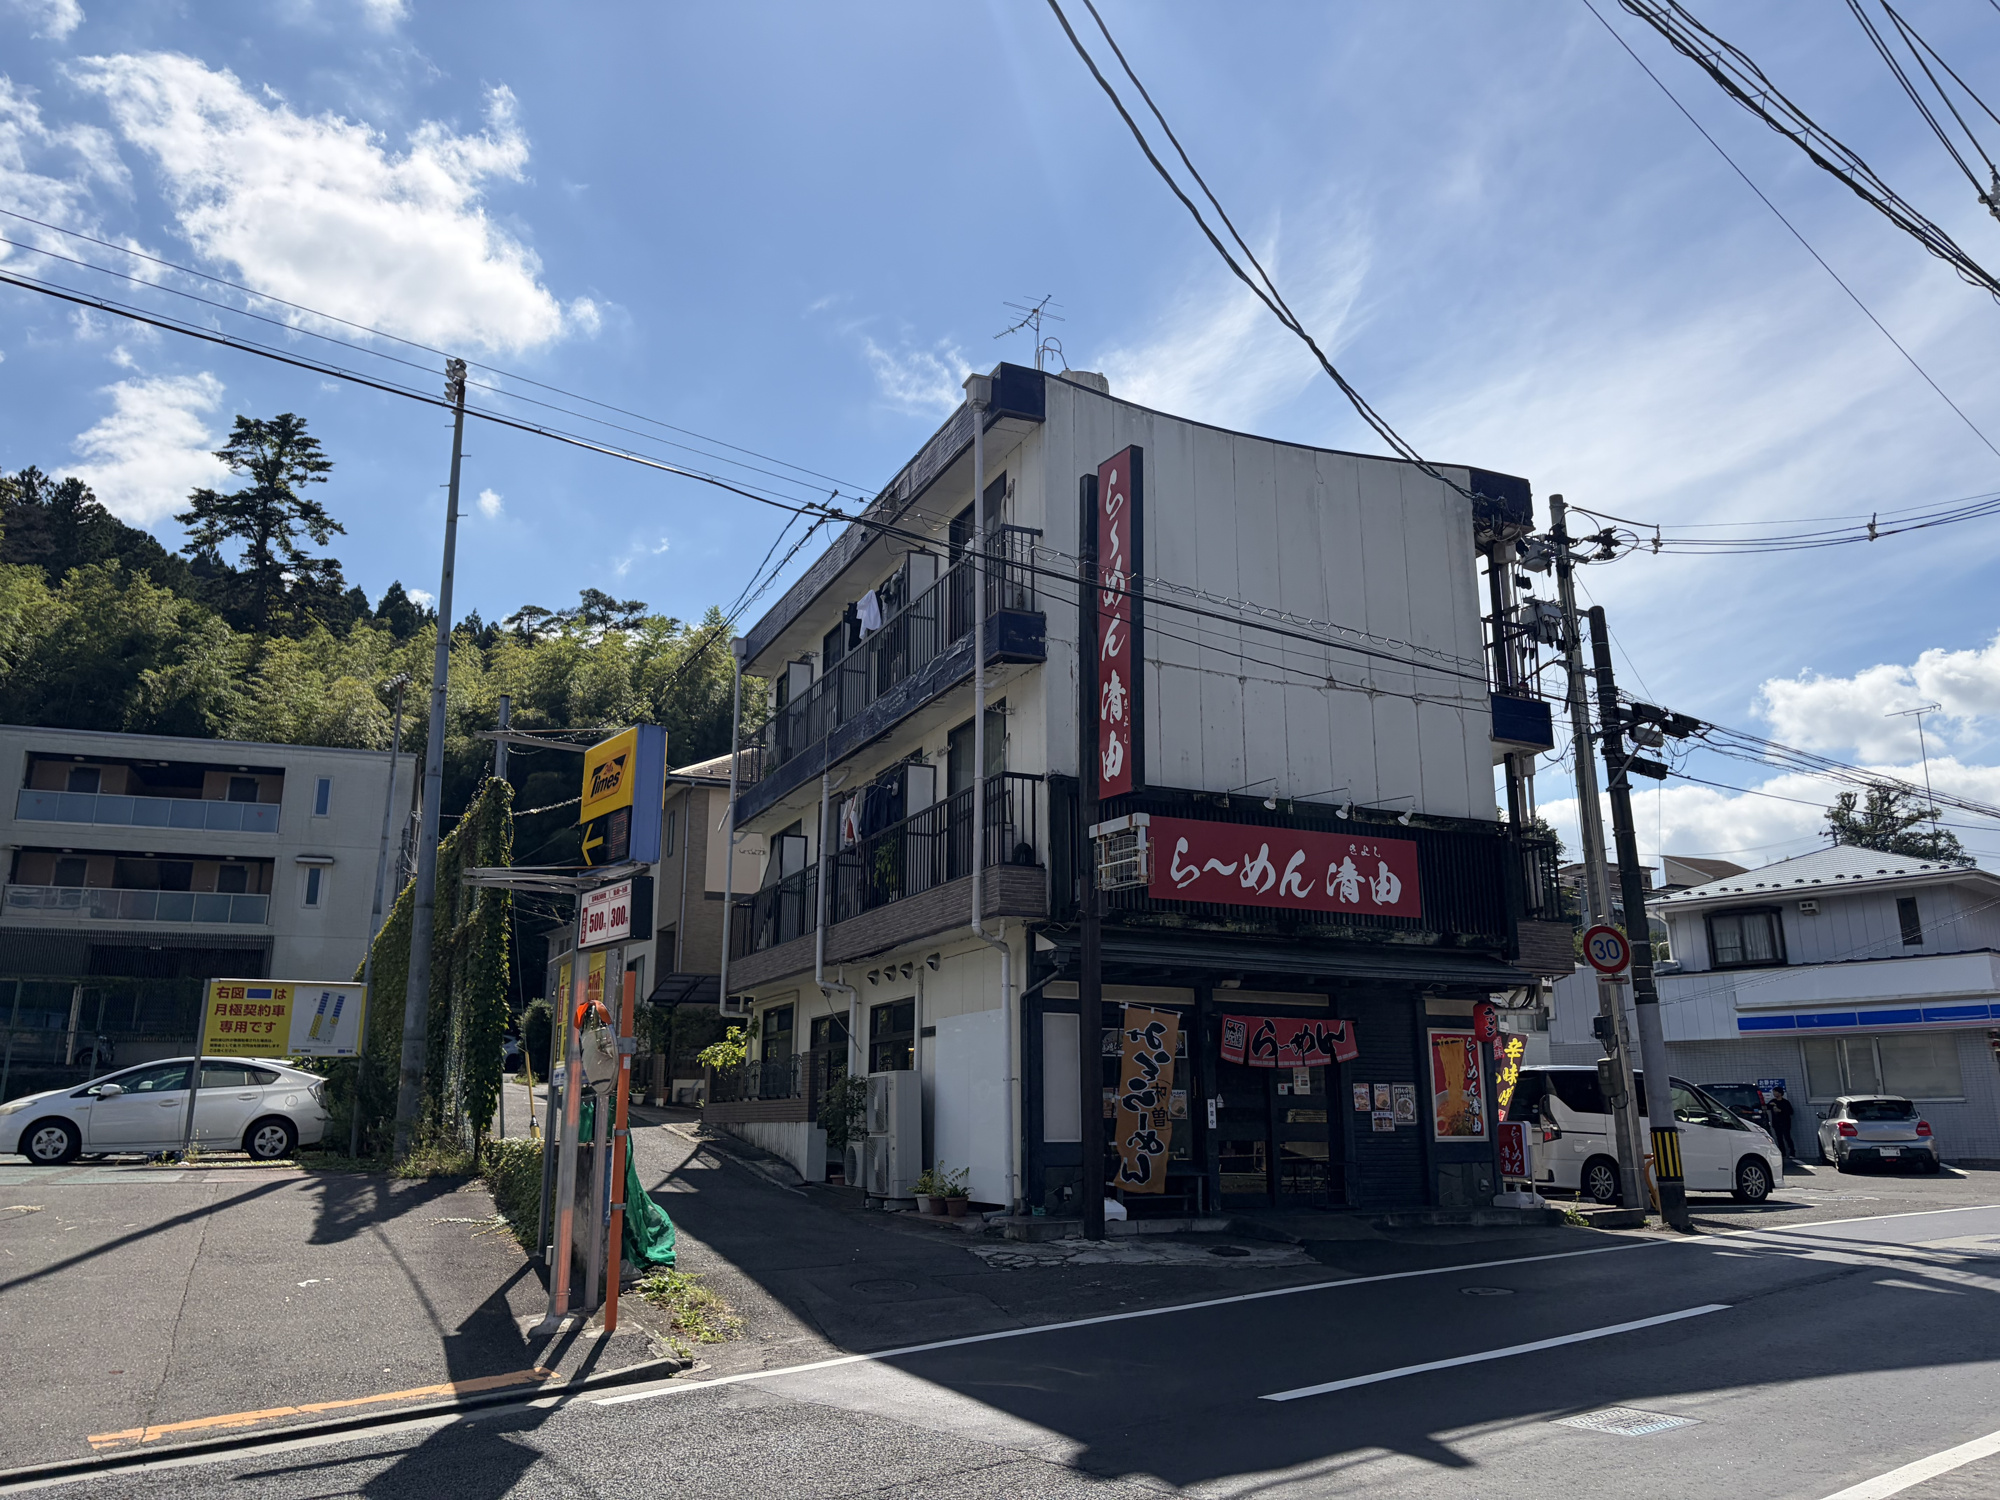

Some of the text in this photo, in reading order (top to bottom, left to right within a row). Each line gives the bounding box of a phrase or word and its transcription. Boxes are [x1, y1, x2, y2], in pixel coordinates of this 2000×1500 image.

[591, 771, 621, 798] Times
[1593, 938, 1620, 961] 30
[216, 986, 287, 1000] 右図 は
[214, 1003, 286, 1017] 月極契約車
[219, 1020, 277, 1034] 専用です
